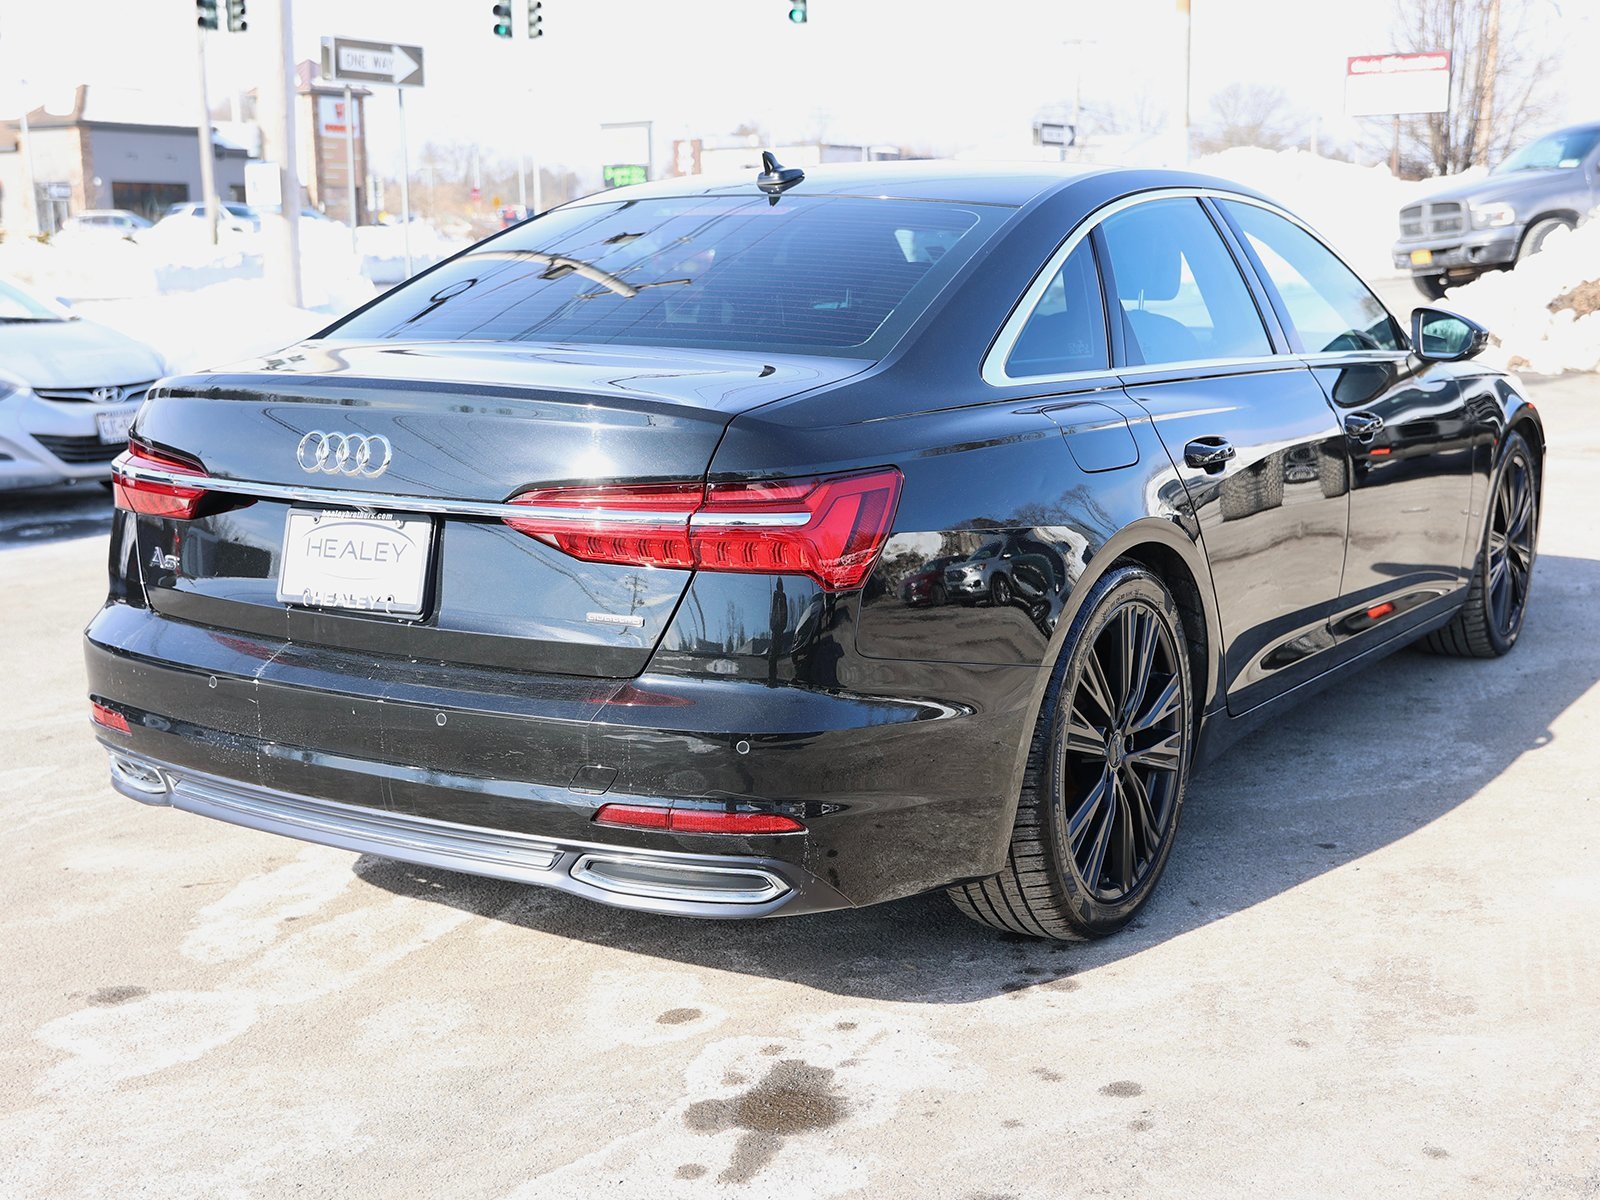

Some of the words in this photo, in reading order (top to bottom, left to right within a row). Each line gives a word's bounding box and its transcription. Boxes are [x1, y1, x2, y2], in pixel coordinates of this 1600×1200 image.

[345, 53, 366, 69] ONE
[373, 56, 394, 71] WAY
[306, 537, 408, 563] HEALEY
[311, 591, 382, 610] HEALEY
